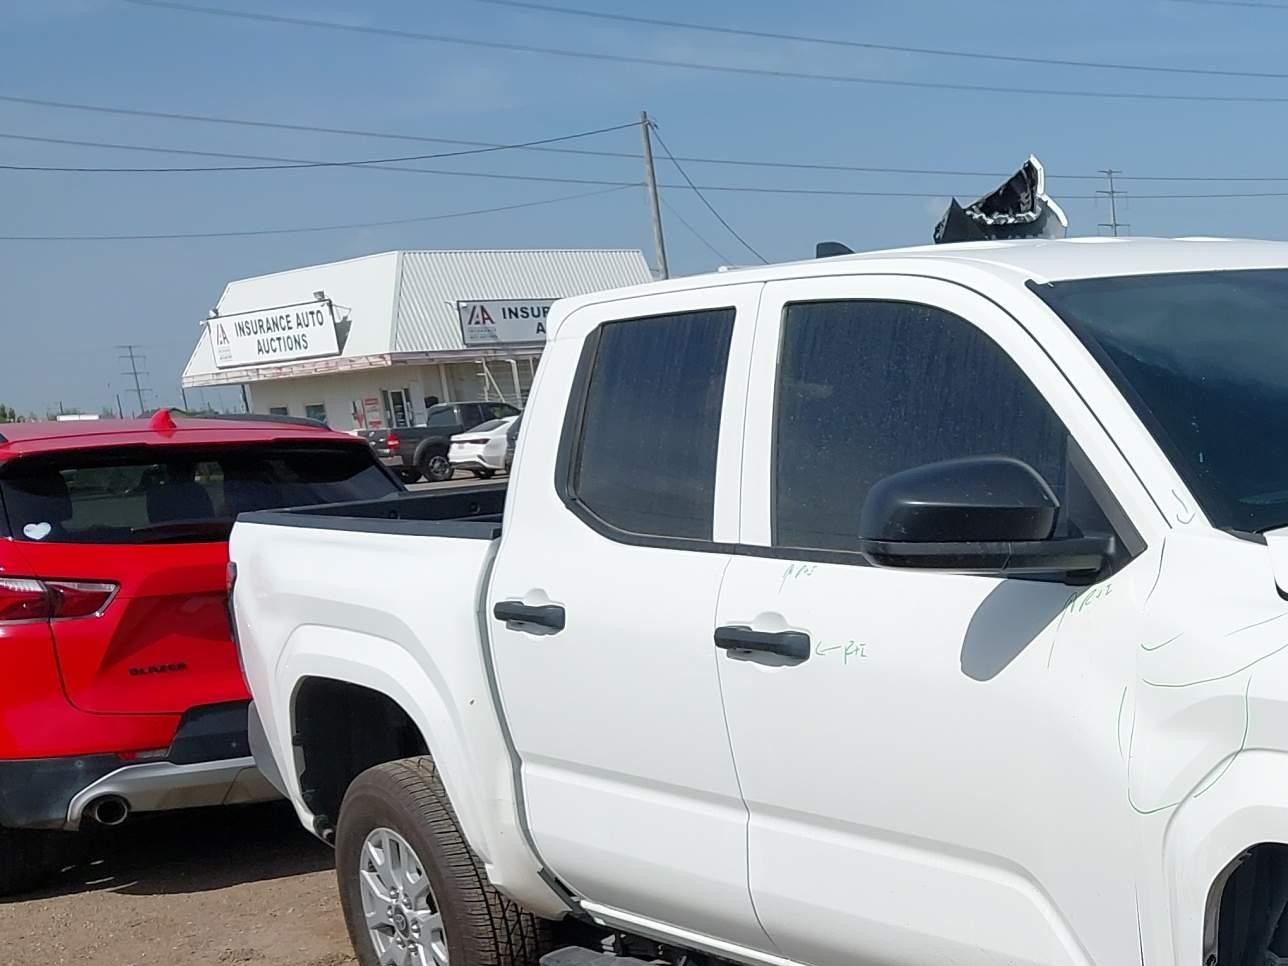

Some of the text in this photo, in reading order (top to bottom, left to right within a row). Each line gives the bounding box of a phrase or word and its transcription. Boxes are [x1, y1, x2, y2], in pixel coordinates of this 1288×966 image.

[235, 309, 324, 338] INSURANCE AUTO
[502, 306, 550, 319] INSUR
[257, 333, 309, 355] AUCTIONS
